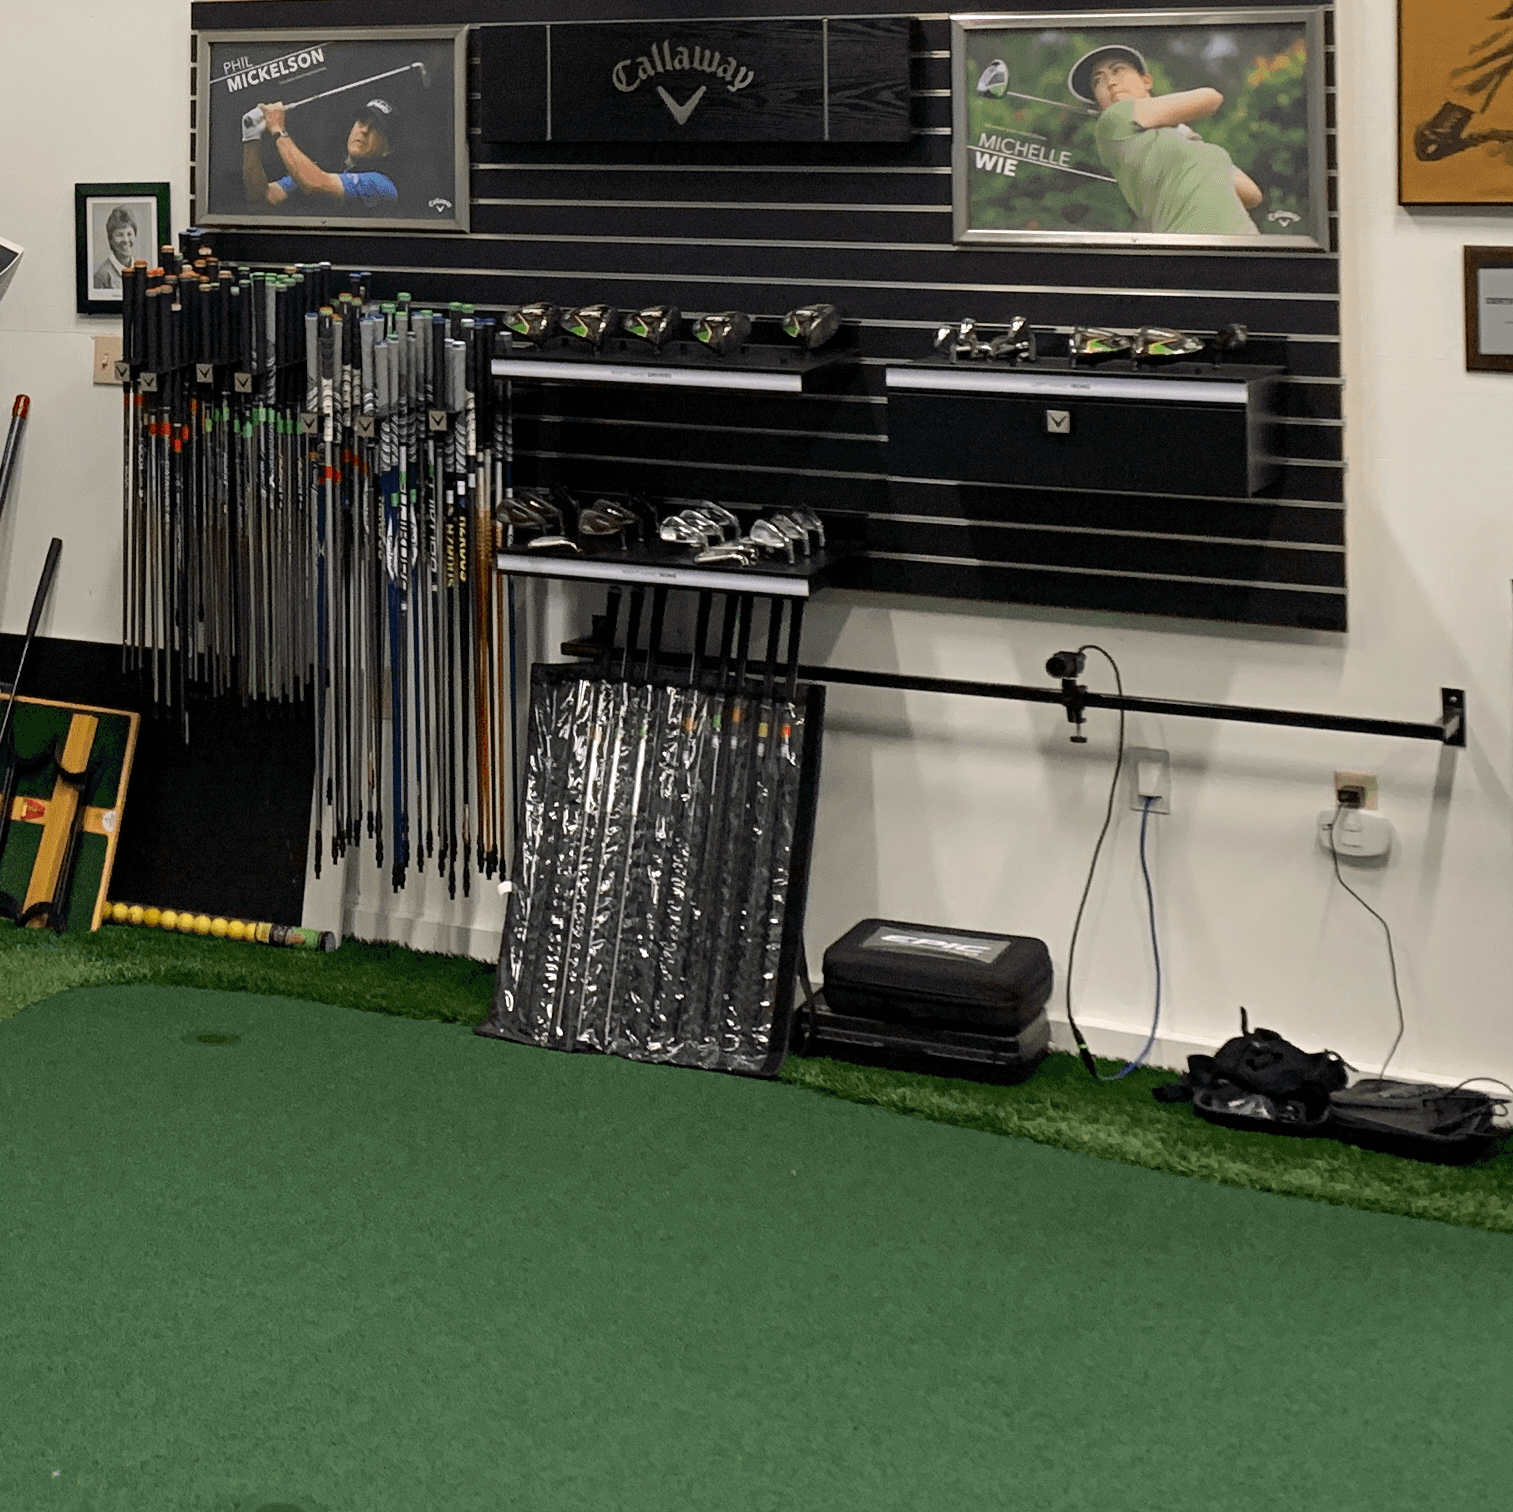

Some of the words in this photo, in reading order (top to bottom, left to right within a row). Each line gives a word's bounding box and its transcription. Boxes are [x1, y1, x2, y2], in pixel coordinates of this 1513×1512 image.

[223, 56, 253, 74] PHIL
[227, 48, 324, 93] MICKELSON
[612, 39, 755, 93] Callaway
[975, 151, 1018, 177] WIE
[978, 133, 1073, 167] MICHELLE
